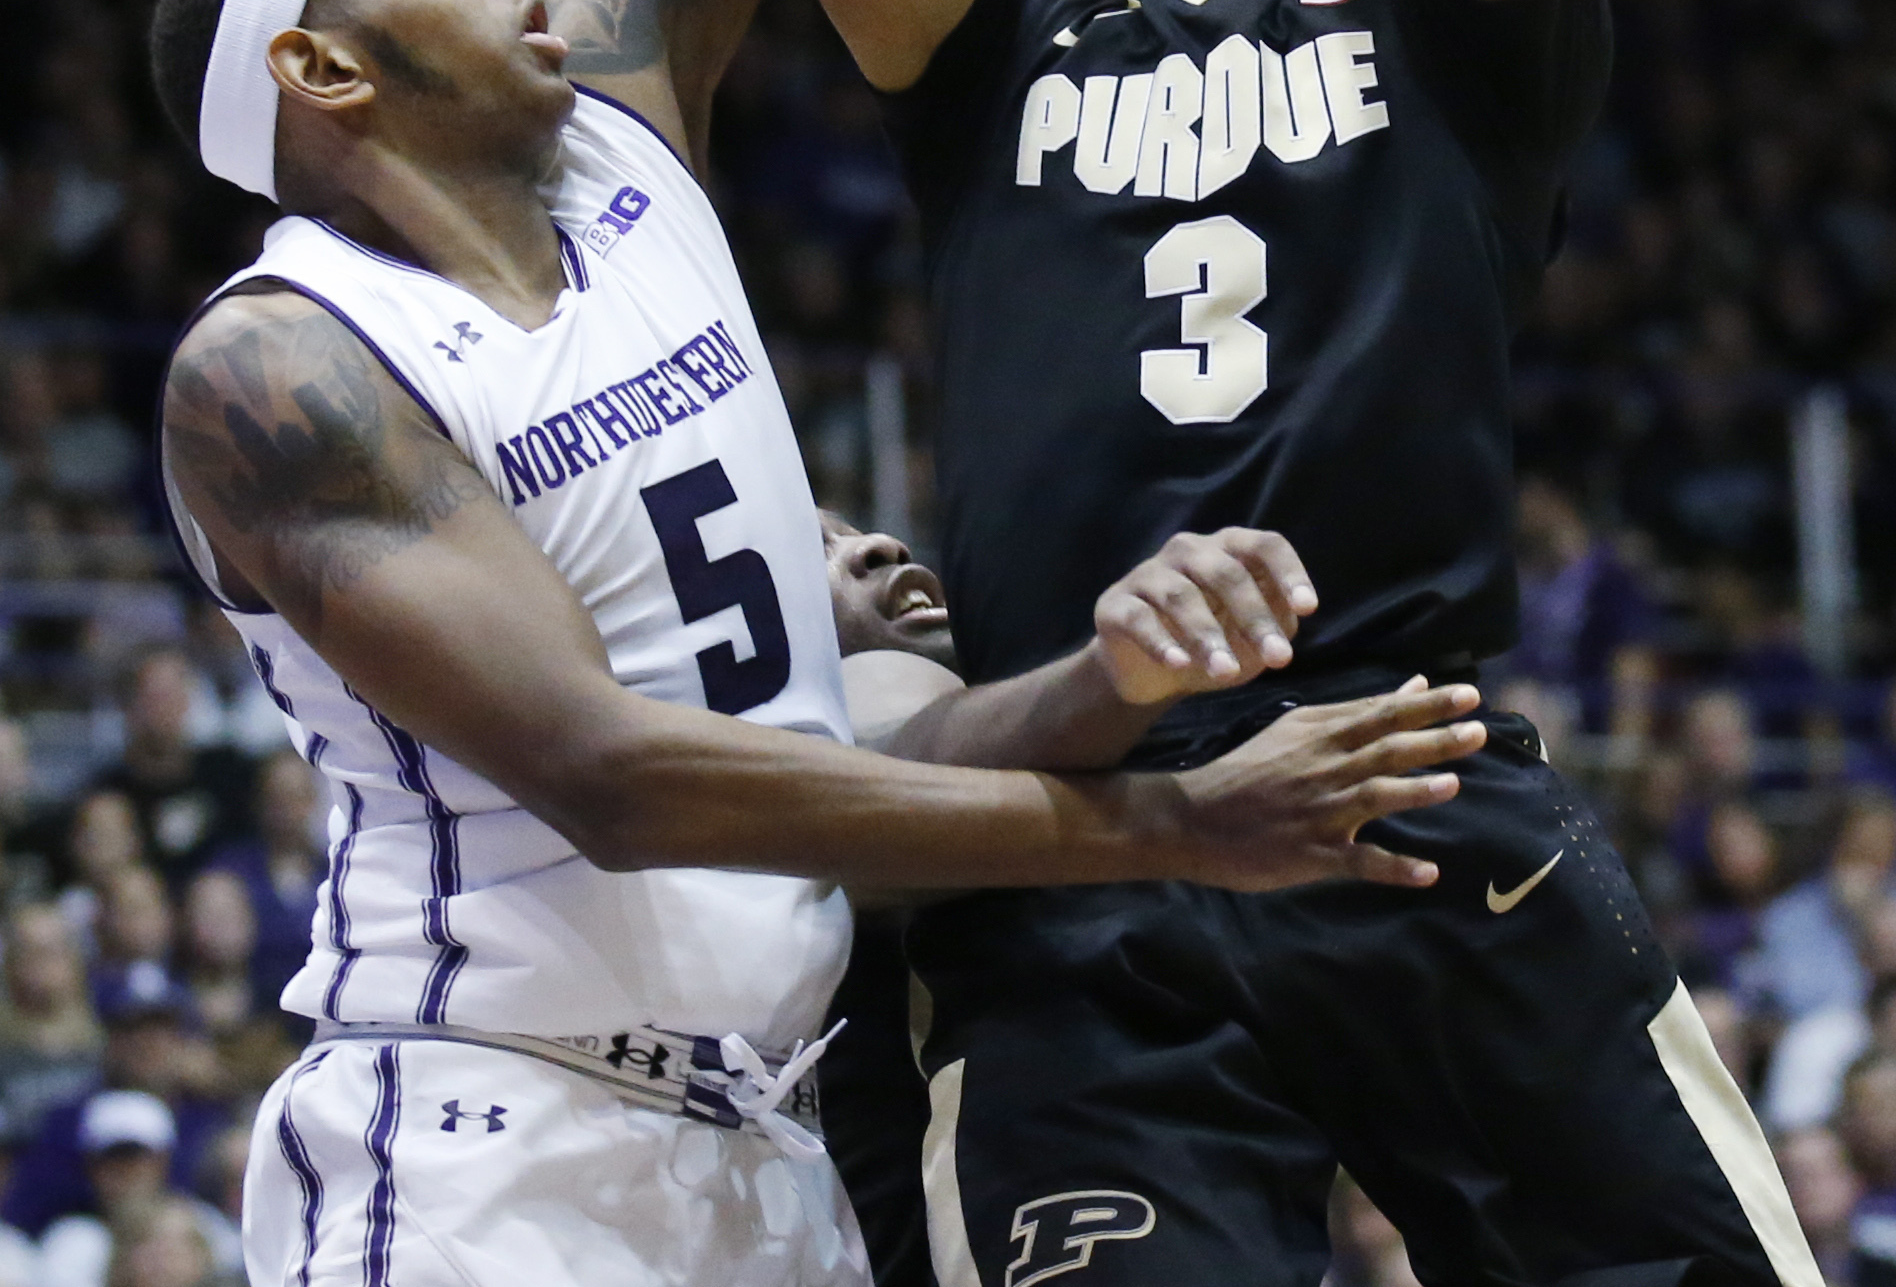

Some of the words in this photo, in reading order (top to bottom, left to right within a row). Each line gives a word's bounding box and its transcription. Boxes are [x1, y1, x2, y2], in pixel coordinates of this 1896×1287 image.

[1016, 31, 1390, 202] PURDUE
[495, 319, 754, 506] NORTHWESERN
[1141, 214, 1268, 425] 3
[640, 458, 791, 716] 5
[1004, 1189, 1156, 1287] P
